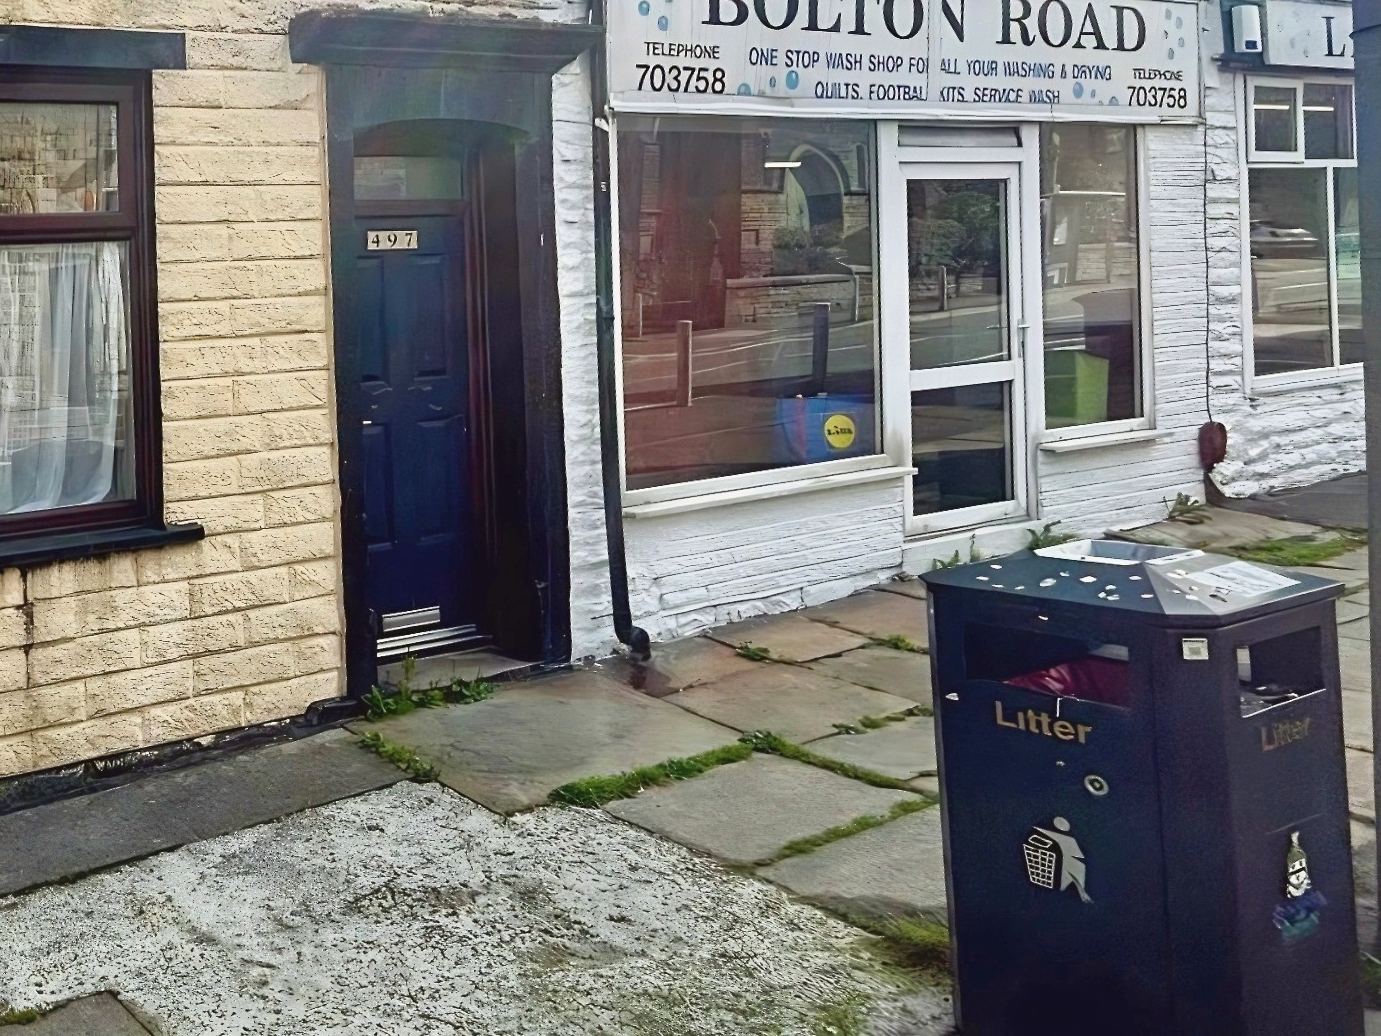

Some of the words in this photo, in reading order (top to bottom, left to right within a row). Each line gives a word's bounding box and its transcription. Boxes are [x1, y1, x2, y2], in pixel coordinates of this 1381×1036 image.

[644, 41, 720, 59] TELEPHONE
[748, 46, 778, 66] ONE
[785, 48, 820, 70] STOP
[826, 50, 863, 71] WASH
[868, 53, 904, 73] SHOP
[908, 56, 928, 74] FO
[940, 58, 961, 74] ALL
[966, 59, 998, 77] YOUR
[1003, 60, 1055, 79] WASHING
[1060, 63, 1067, 79] &
[1072, 64, 1112, 81] DRYING
[635, 64, 727, 94] 703758
[869, 83, 928, 102] FOOTBAL
[973, 86, 1023, 104] SERVICE
[1029, 88, 1060, 104] WASH
[1127, 86, 1188, 109] 703758
[371, 233, 413, 248] 497
[995, 700, 1092, 744] Litter
